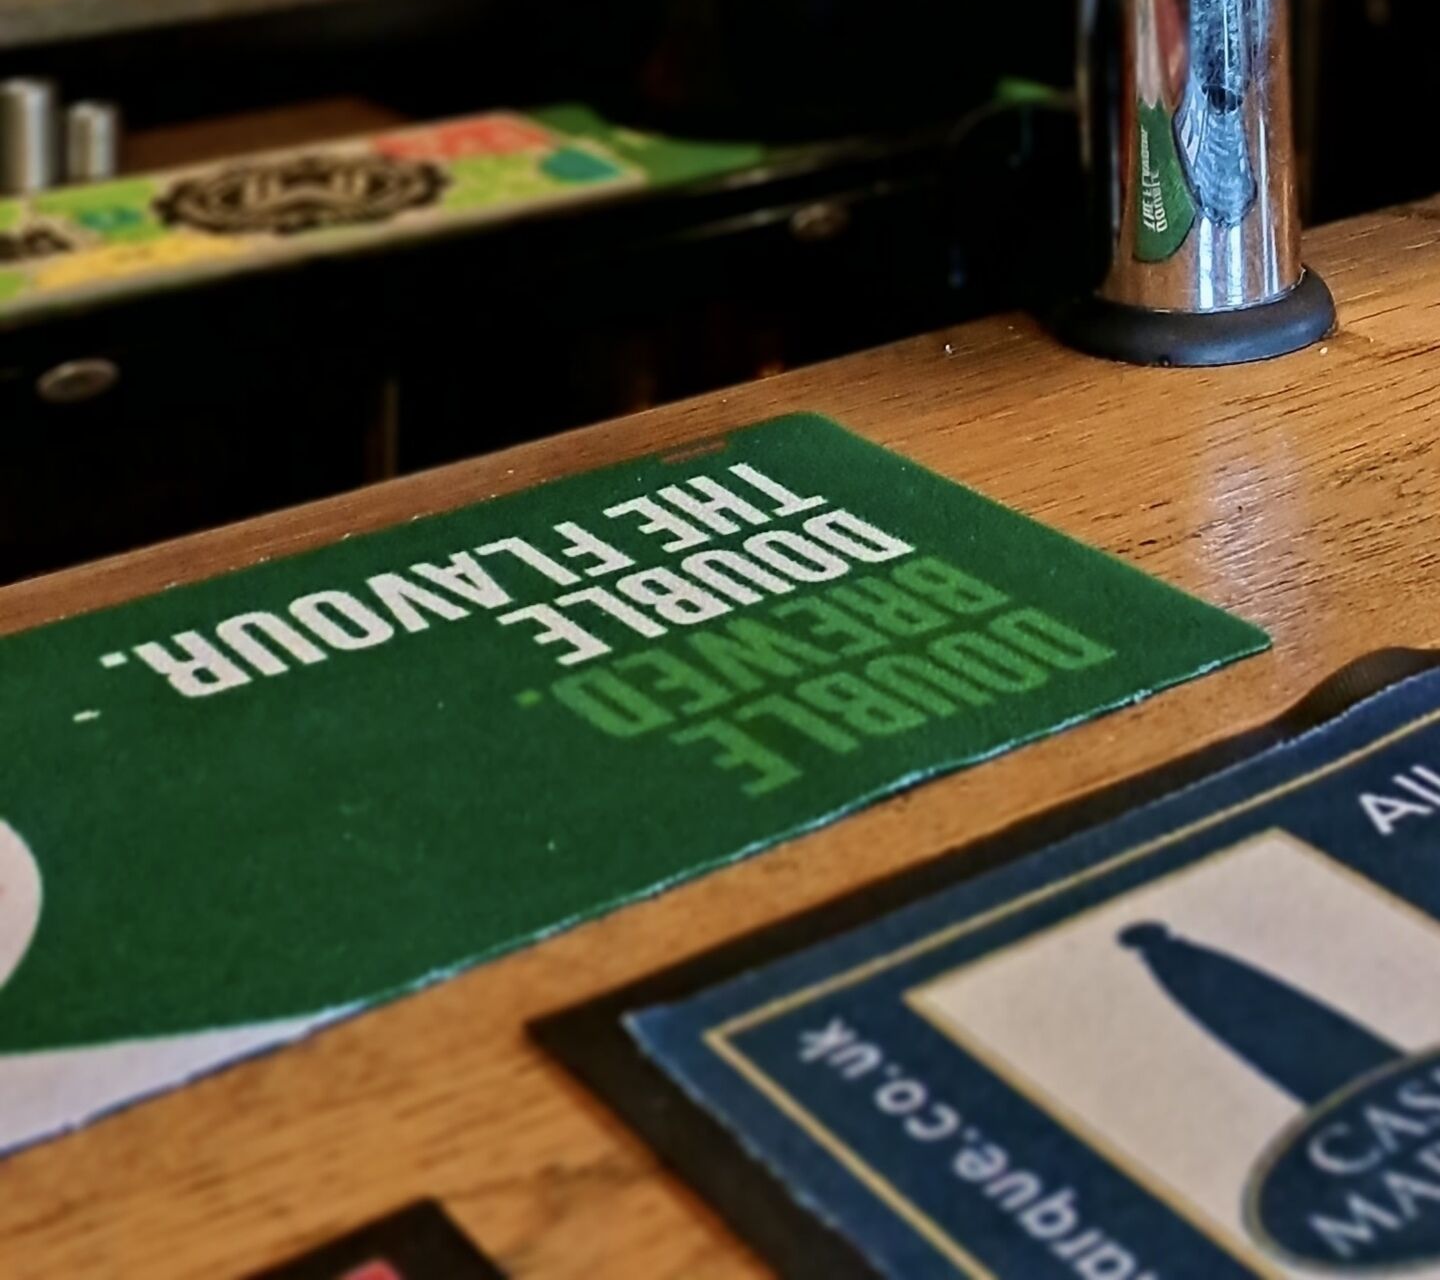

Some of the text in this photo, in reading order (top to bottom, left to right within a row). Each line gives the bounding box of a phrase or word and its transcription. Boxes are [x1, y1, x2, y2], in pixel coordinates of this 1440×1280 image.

[99, 461, 830, 698] THE FLAVOUR.
[497, 507, 917, 667] DOUBLE
[517, 554, 1011, 738] BREWED.
[670, 606, 1118, 797] DOUBLE
